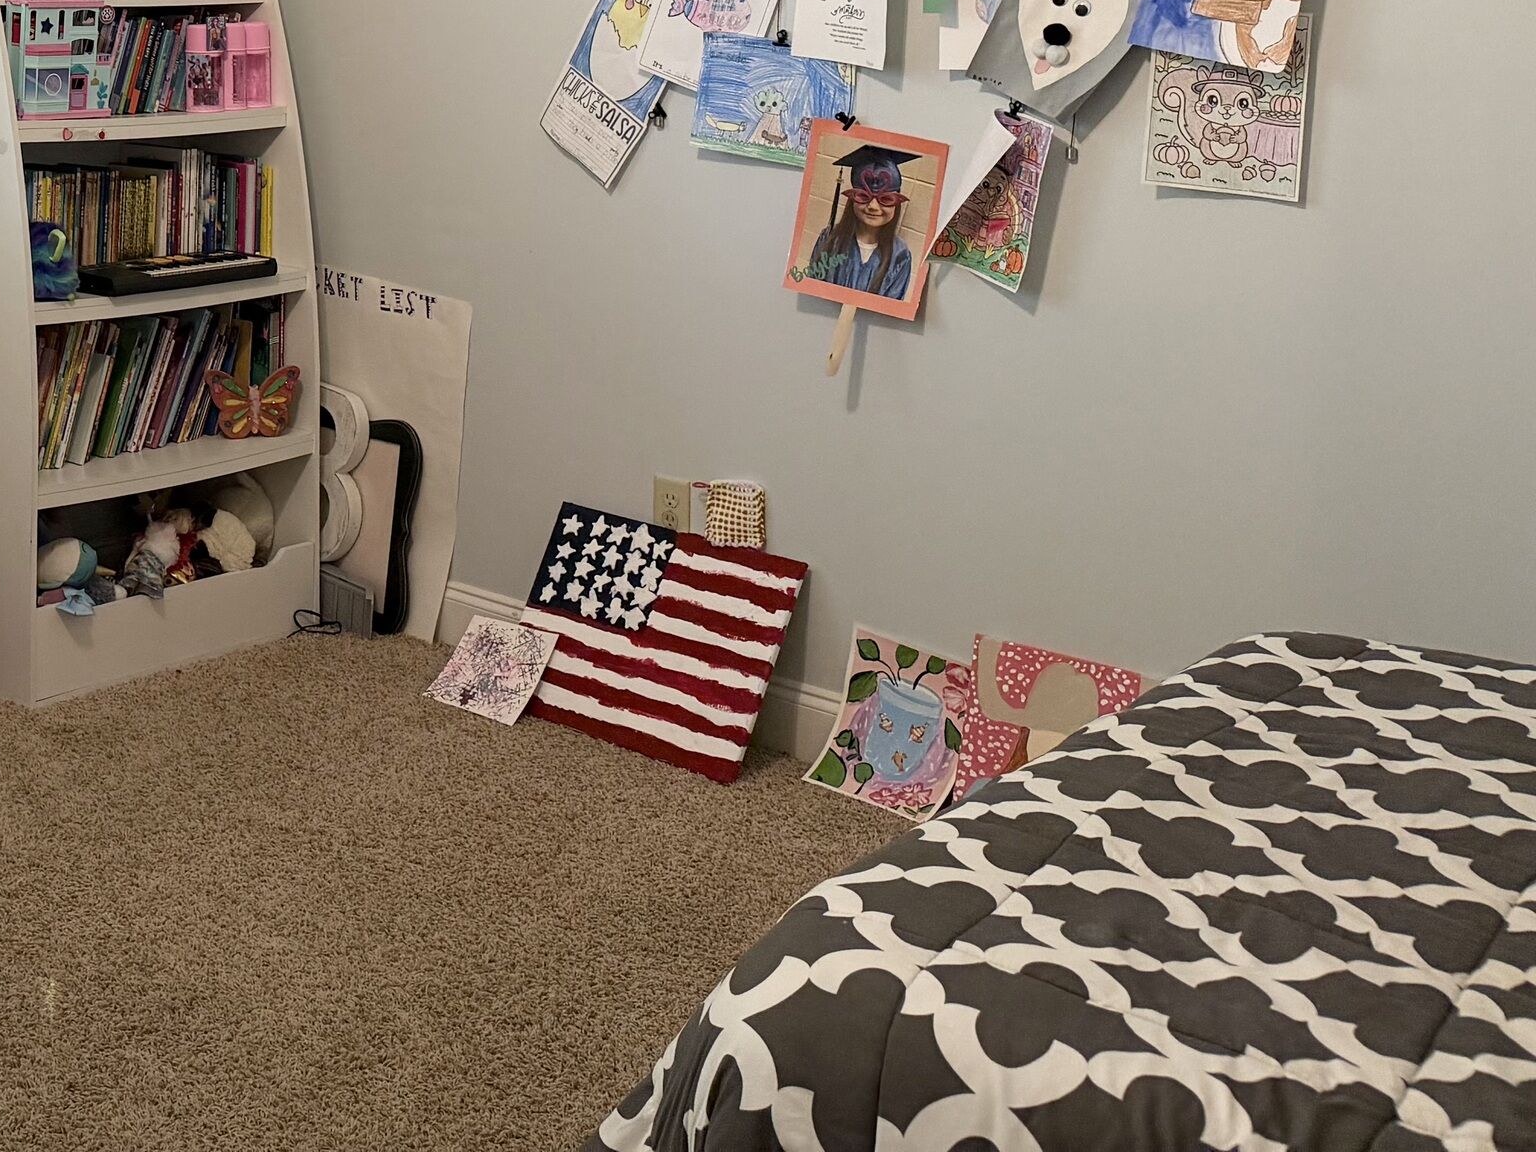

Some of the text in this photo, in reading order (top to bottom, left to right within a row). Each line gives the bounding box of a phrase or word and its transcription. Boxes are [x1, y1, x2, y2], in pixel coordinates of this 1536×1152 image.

[562, 71, 596, 109] CHICKS
[595, 101, 637, 145] SALSA
[315, 266, 438, 320] KET LIST
